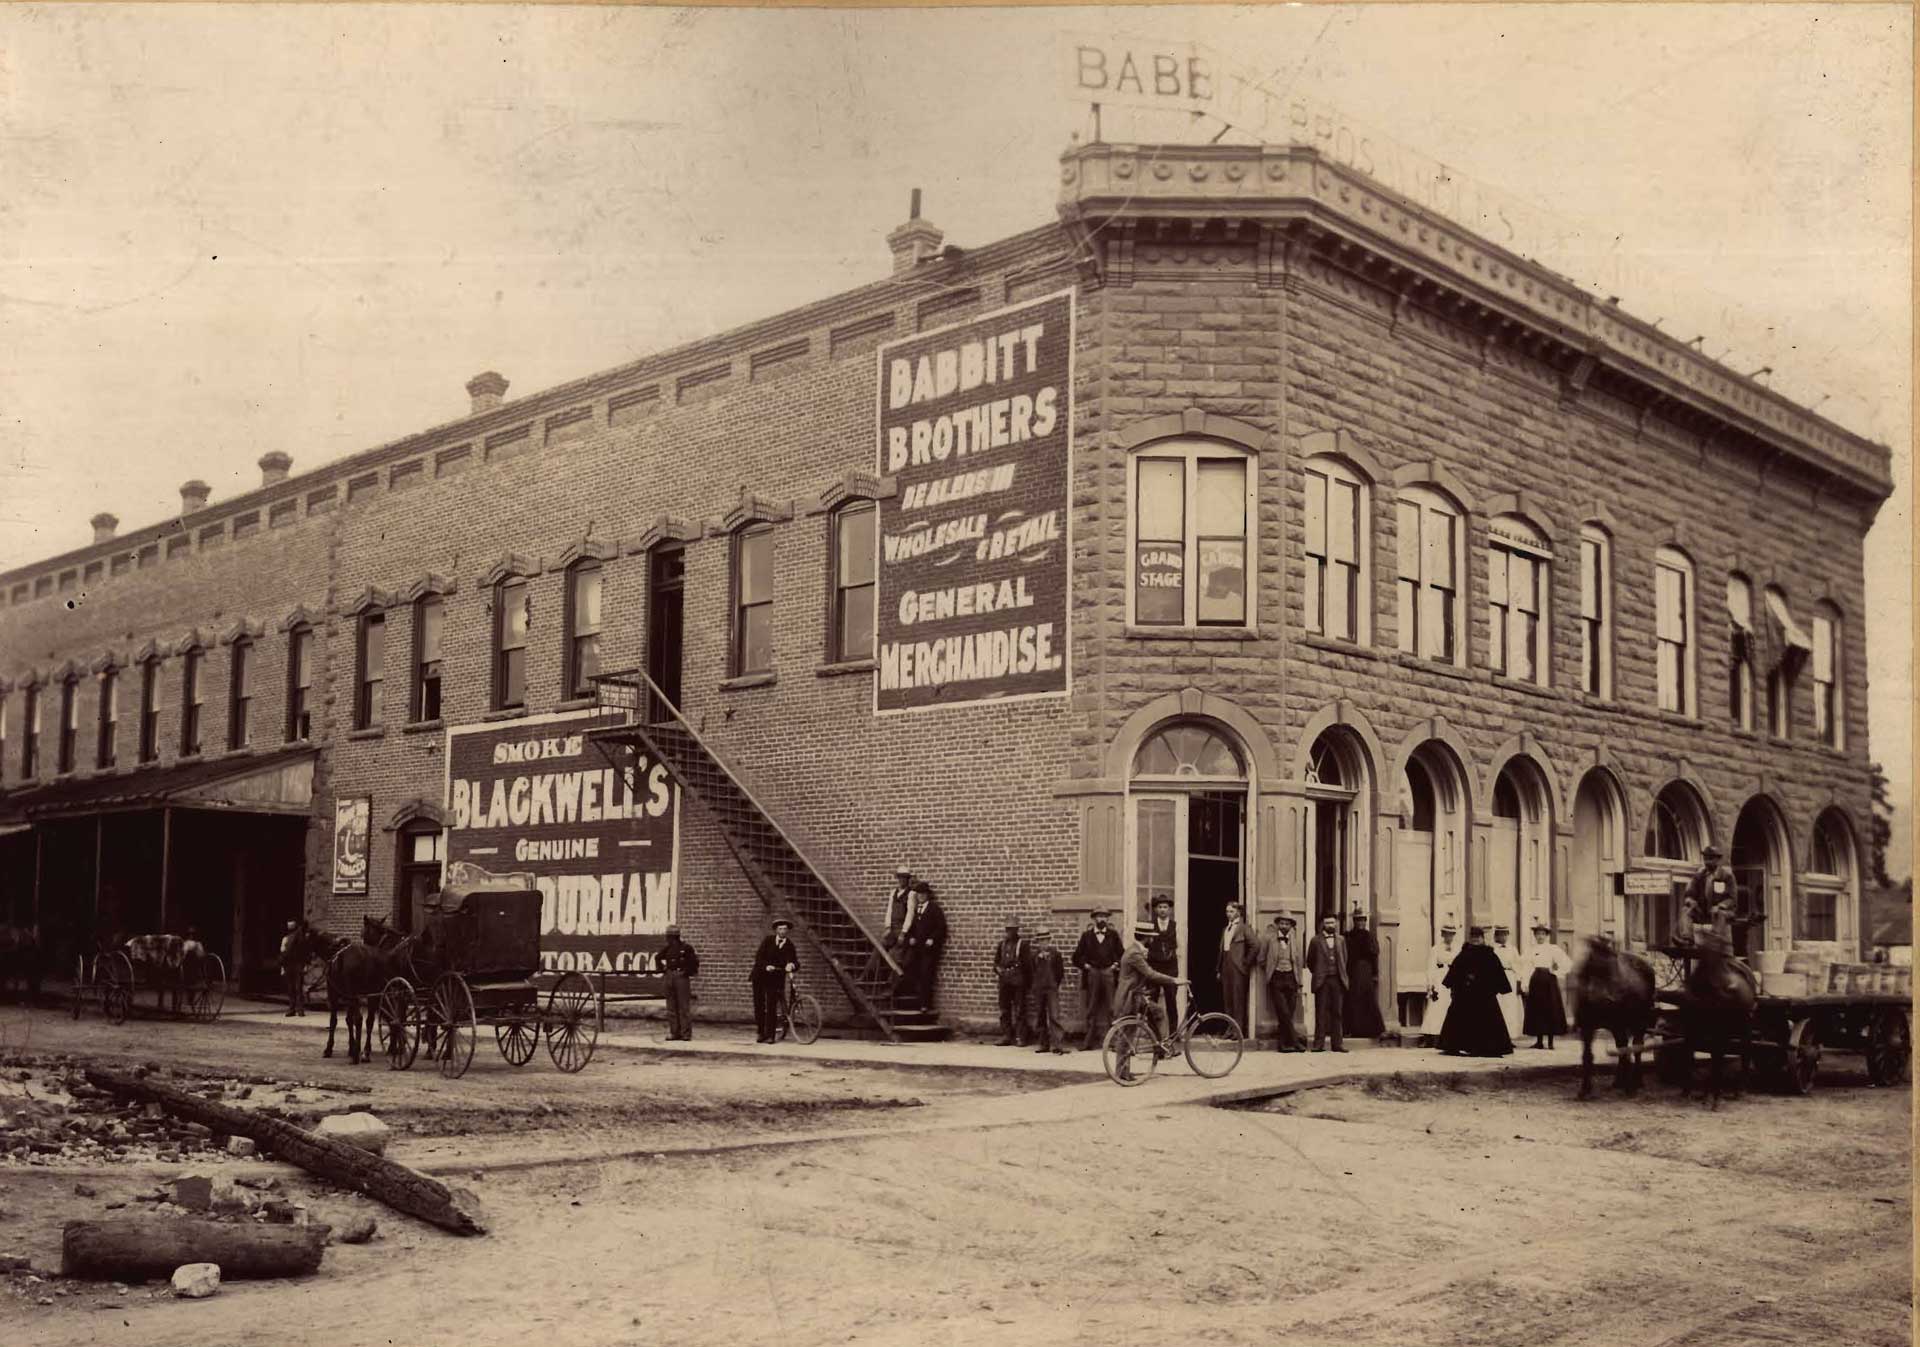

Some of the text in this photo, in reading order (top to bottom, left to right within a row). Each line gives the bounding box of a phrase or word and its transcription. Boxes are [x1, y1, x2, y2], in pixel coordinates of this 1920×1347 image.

[889, 323, 1044, 410] BABBITT
[888, 386, 1058, 472] BROTHERS
[884, 514, 988, 562] WHOLESALE
[988, 510, 1062, 561] RETAIL
[1139, 551, 1183, 568] GRAND
[898, 575, 1034, 625] GENERAL
[1139, 572, 1182, 588] STAGE
[880, 622, 1063, 690] MERCHANDISE.
[494, 735, 583, 765] SMOKE
[452, 755, 669, 830] BLACKWELL'S
[515, 838, 599, 862] GENUINE
[536, 872, 672, 936] DURHAM
